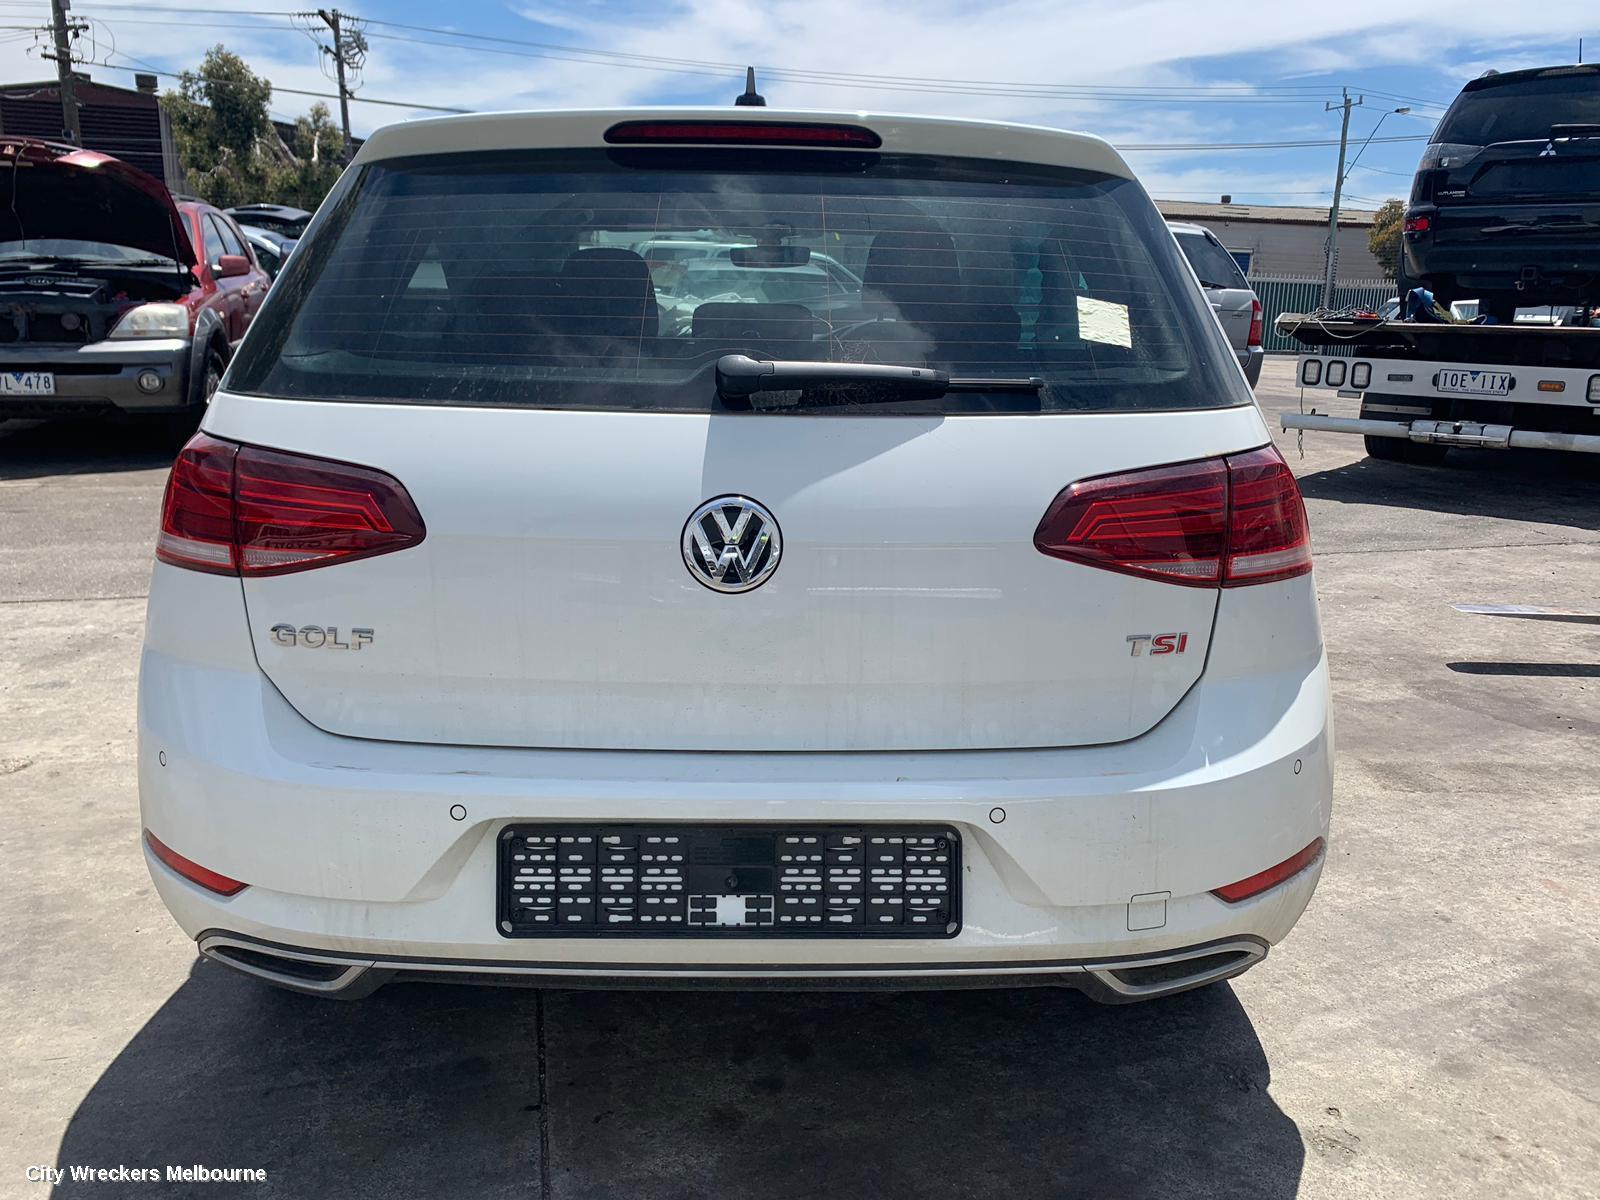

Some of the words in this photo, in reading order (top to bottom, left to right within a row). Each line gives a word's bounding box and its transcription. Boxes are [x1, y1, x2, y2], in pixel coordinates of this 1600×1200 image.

[24, 375, 51, 390] 478
[687, 499, 777, 588] VW
[270, 623, 375, 651] GOLF
[1126, 632, 1188, 657] TSI
